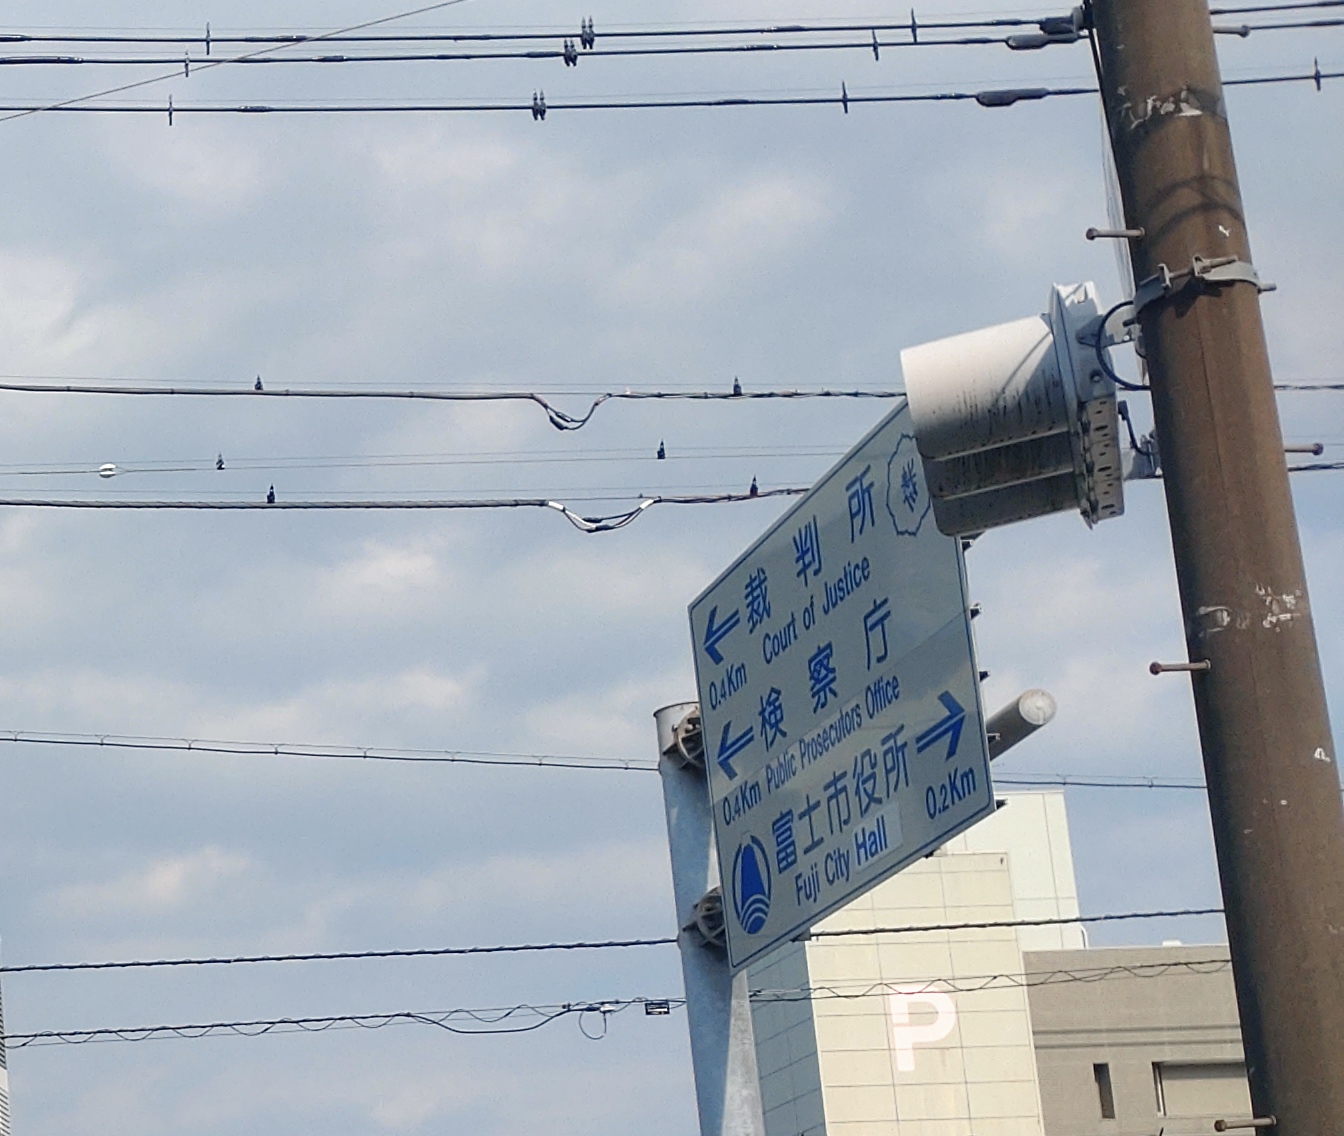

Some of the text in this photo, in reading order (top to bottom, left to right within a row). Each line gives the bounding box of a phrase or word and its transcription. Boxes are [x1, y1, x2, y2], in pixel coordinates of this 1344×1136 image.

[744, 464, 876, 635] 裁判所
[762, 556, 871, 665] Court of Justice
[709, 662, 747, 711] 0.4Km
[758, 597, 891, 753] 検察庁
[722, 676, 900, 827] 0.4Km Public Prosecutors Office
[771, 724, 911, 875] 富士市役所
[924, 767, 977, 820] 0.2Km
[794, 815, 888, 907] Fuji City Hall
[889, 985, 956, 1071] P
